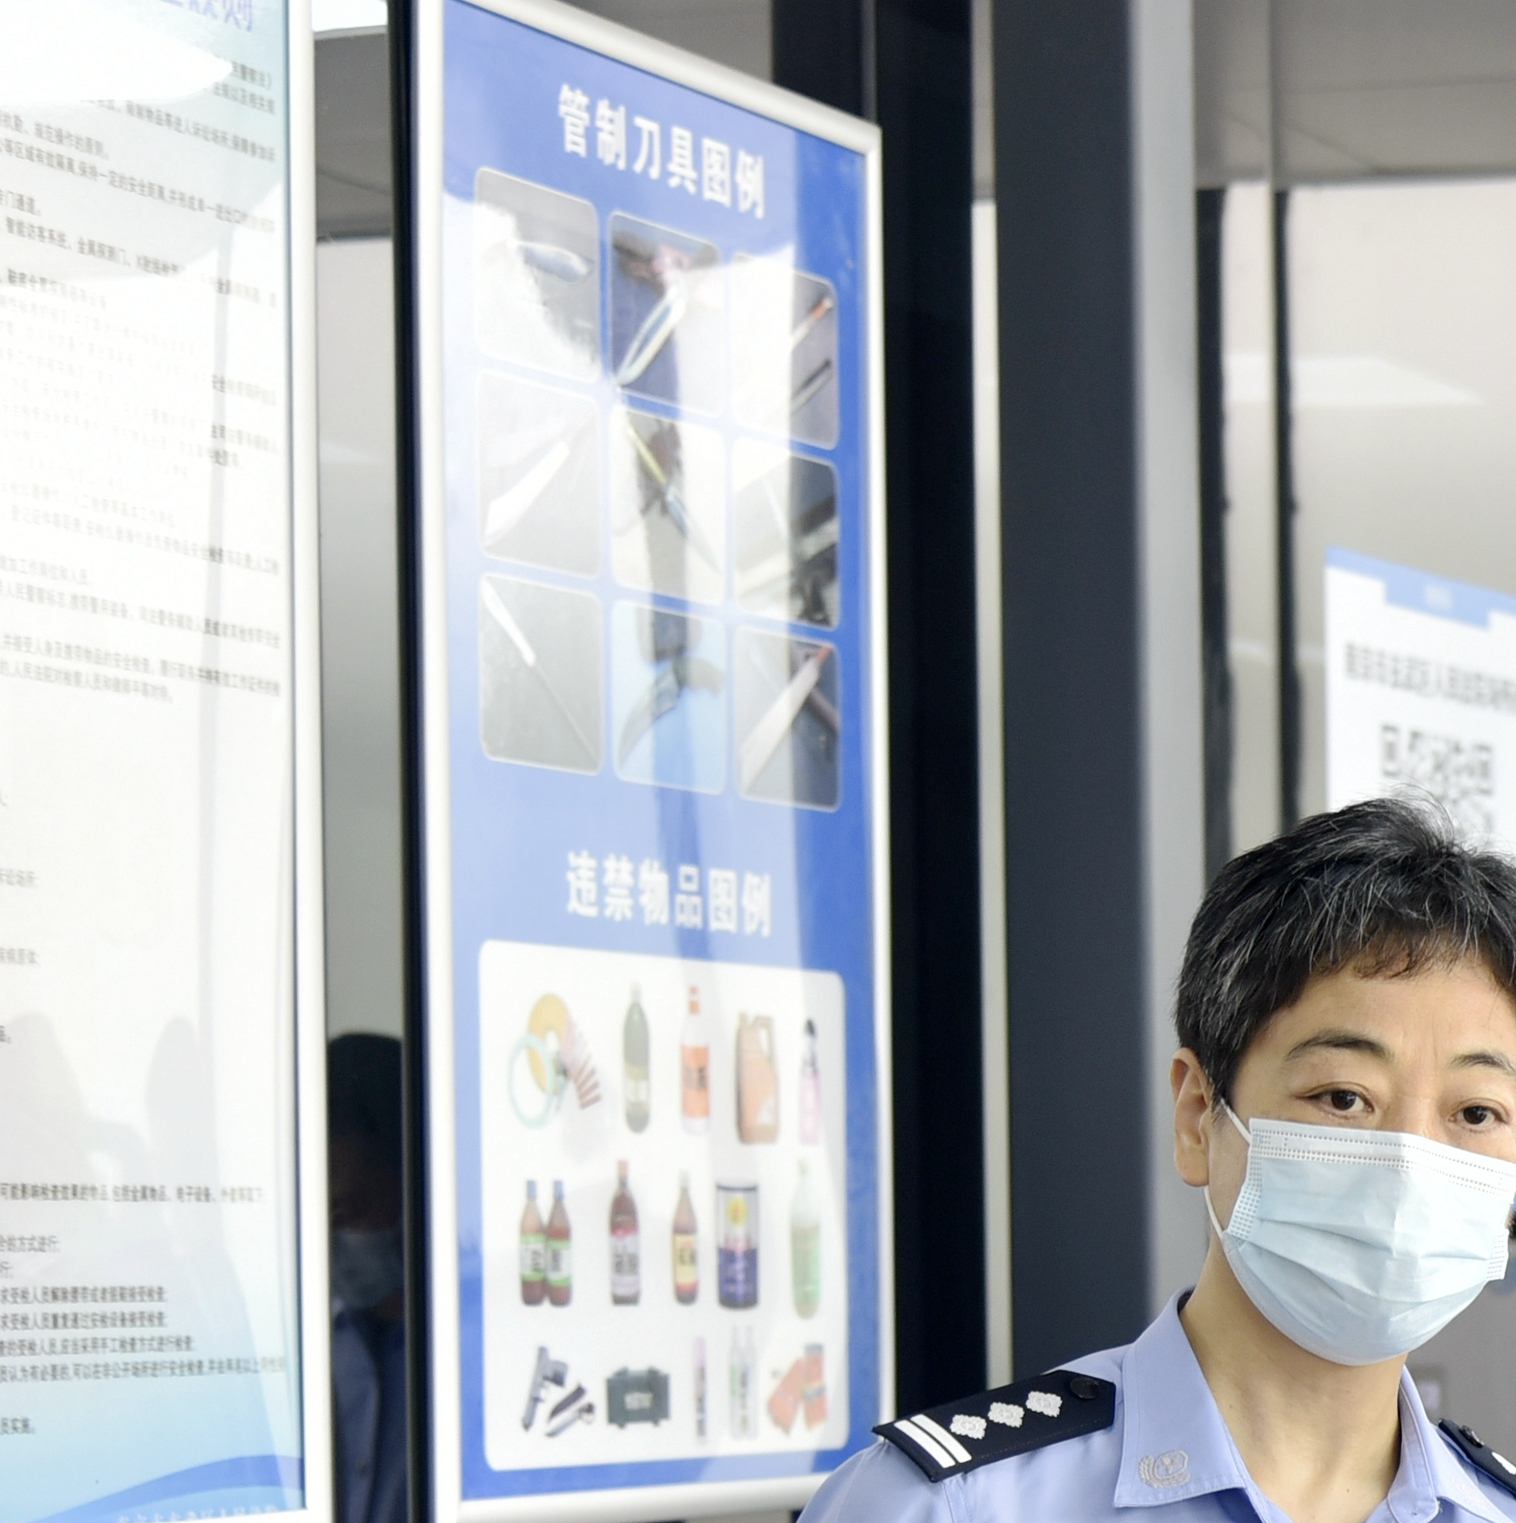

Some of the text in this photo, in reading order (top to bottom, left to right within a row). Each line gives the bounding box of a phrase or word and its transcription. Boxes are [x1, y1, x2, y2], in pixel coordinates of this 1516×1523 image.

[557, 82, 766, 220] 管制刀具图例
[565, 850, 773, 938] 违禁物品图例
